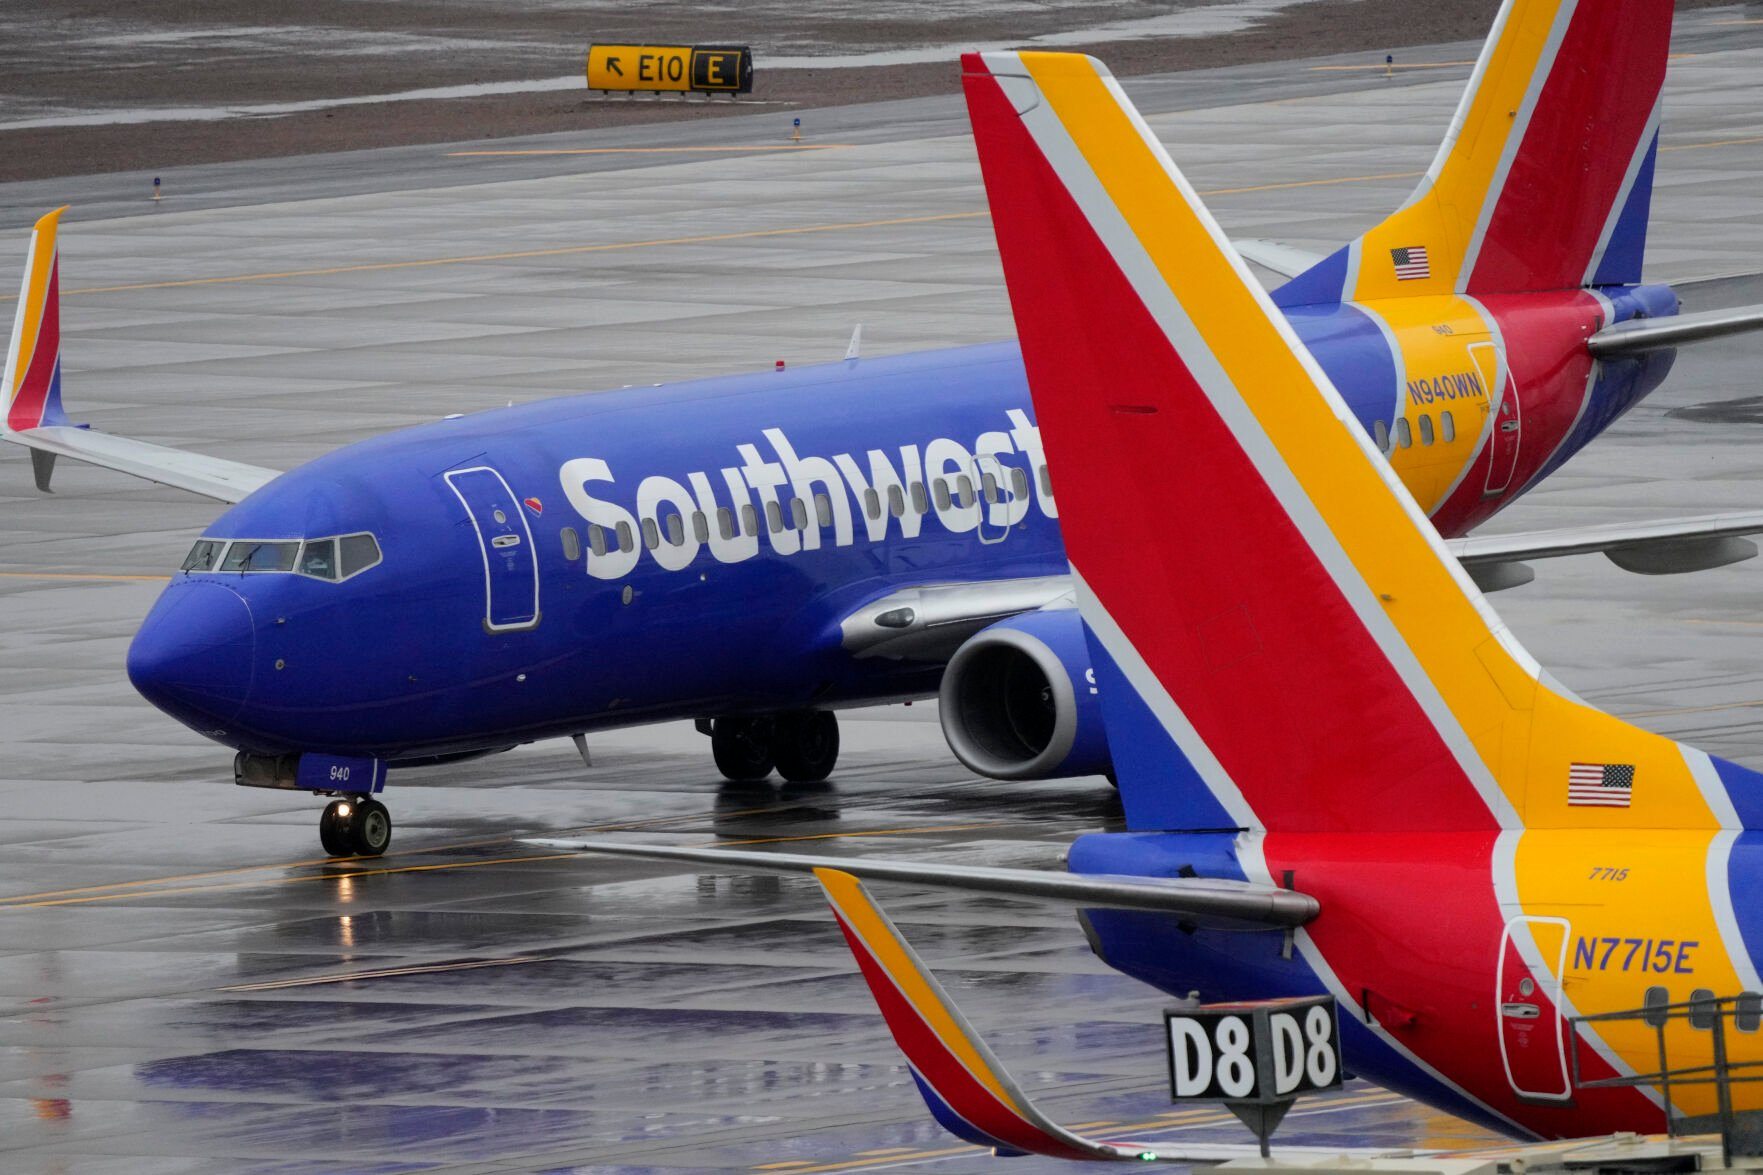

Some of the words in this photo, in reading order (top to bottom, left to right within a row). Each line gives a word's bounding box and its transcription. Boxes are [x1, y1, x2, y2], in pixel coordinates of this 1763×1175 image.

[639, 55, 683, 82] E10
[707, 56, 724, 84] E
[1407, 372, 1482, 405] N940WN
[559, 408, 1059, 580] Southwest
[330, 765, 350, 781] 940
[1588, 867, 1630, 881] 7715
[1573, 936, 1699, 974] N7715E
[1170, 1016, 1255, 1097] D8
[1270, 1005, 1336, 1095] D8
